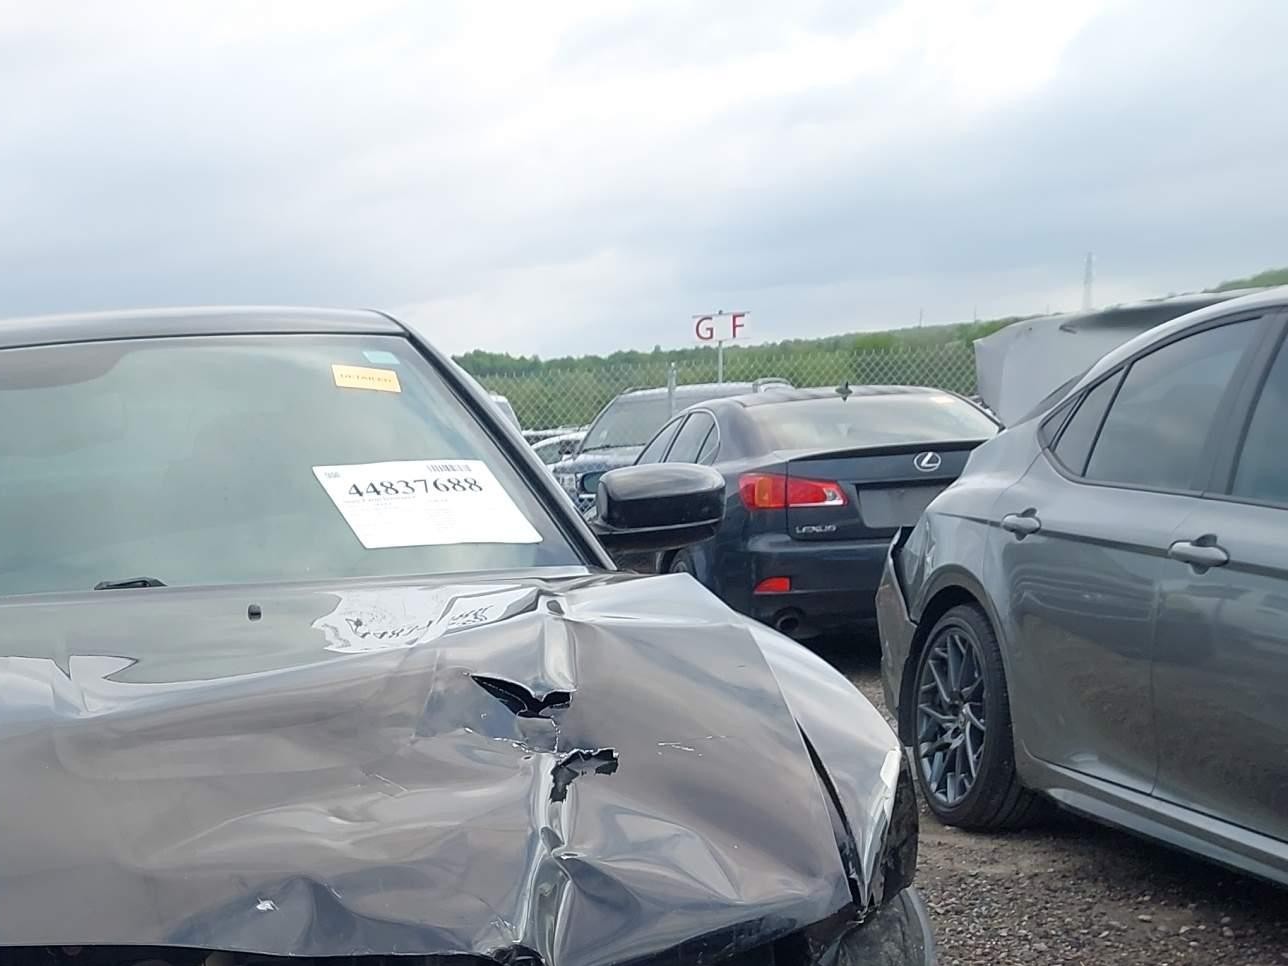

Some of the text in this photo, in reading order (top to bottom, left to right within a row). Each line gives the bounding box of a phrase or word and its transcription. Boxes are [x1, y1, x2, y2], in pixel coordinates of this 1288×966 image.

[696, 313, 745, 340] G F
[348, 477, 483, 497] 44837688
